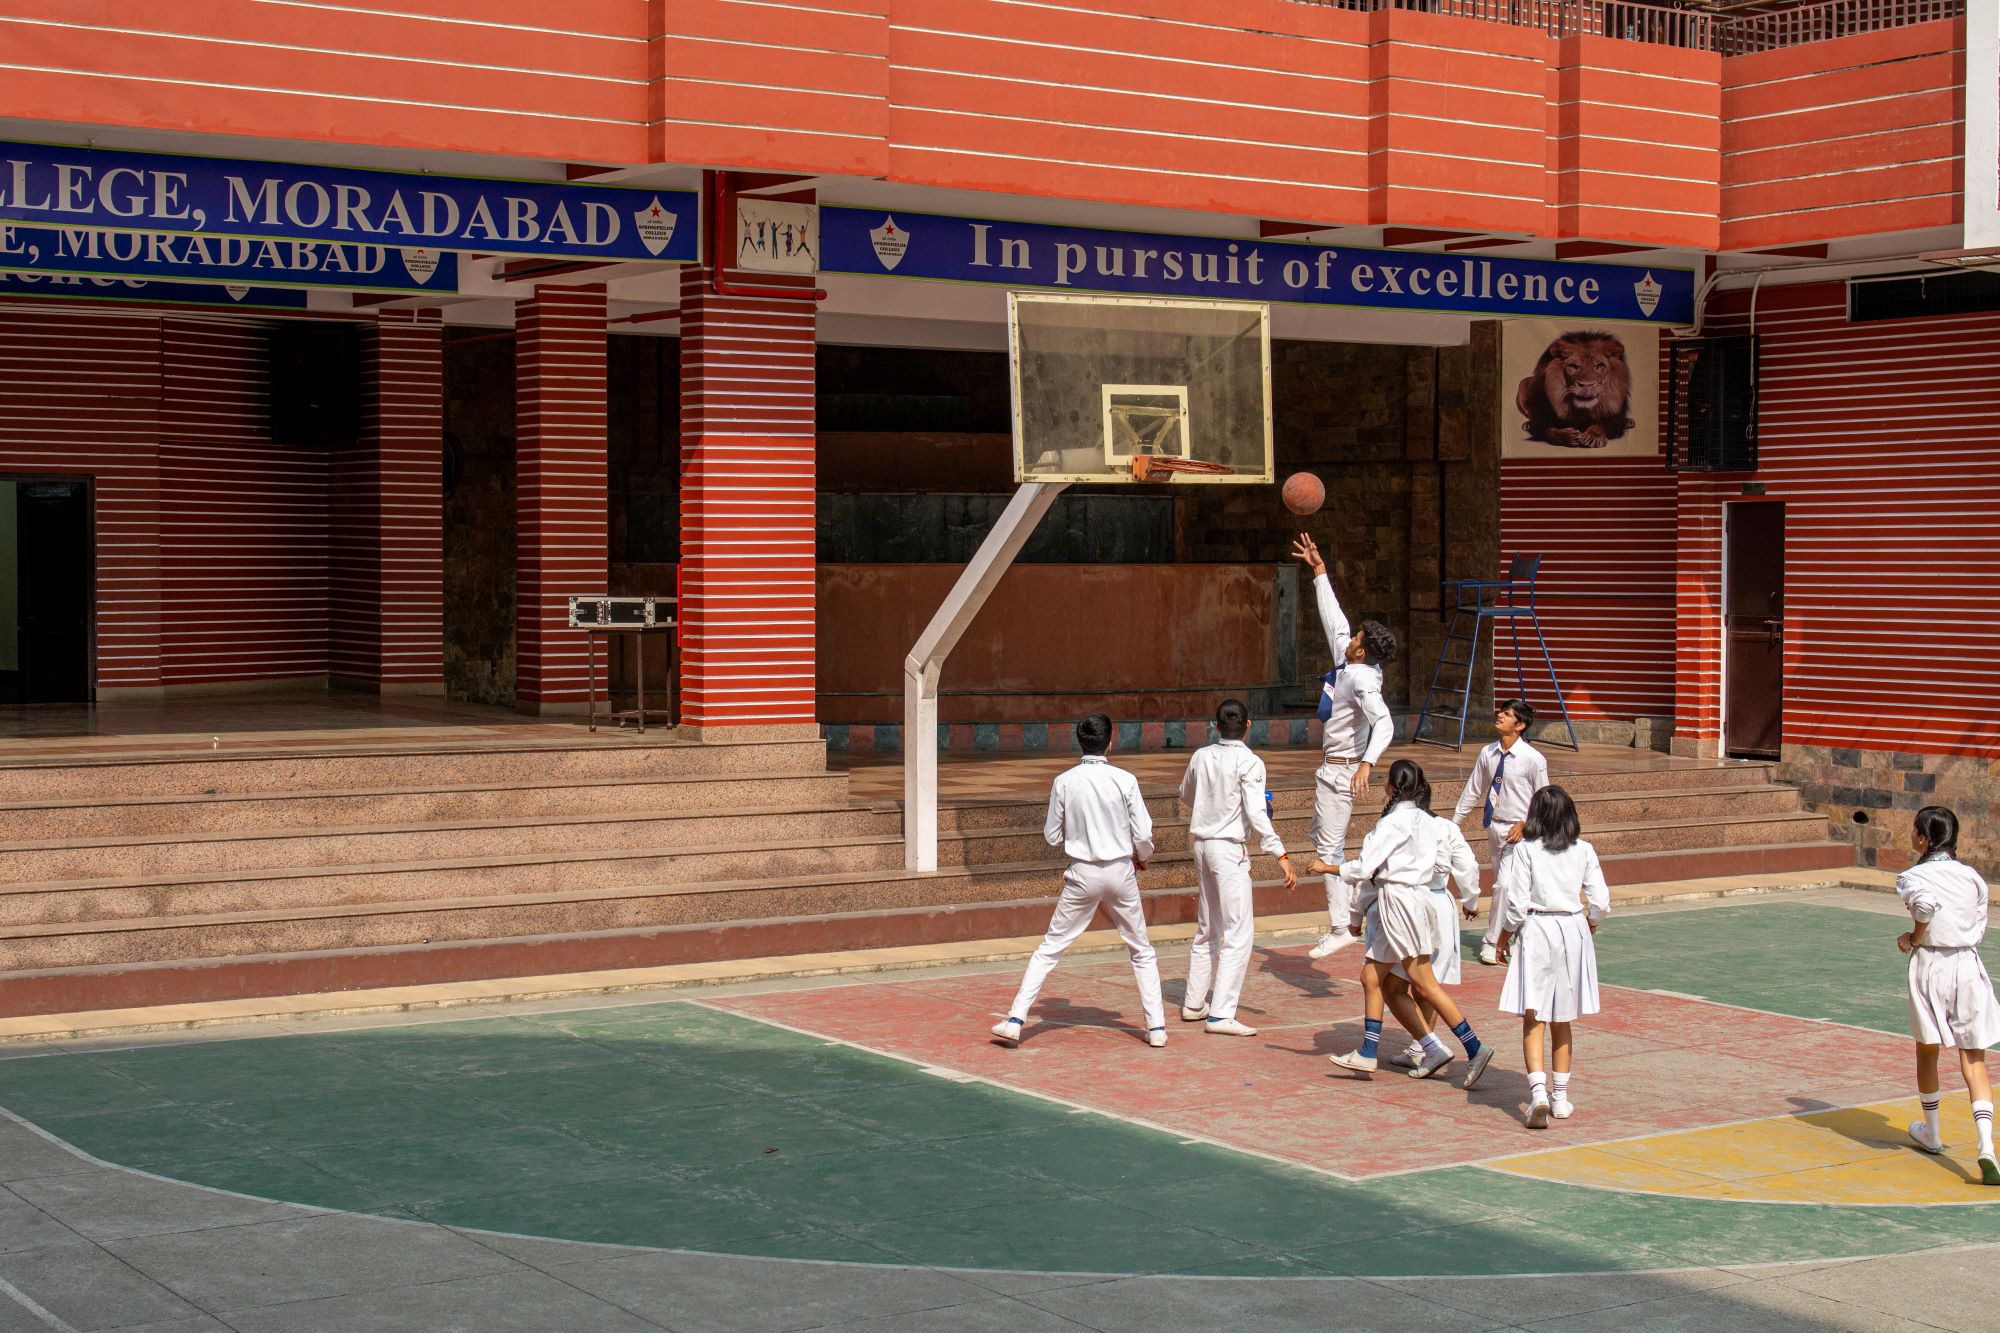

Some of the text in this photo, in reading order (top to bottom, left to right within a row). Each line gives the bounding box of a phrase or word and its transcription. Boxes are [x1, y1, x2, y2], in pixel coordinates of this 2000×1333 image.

[0, 160, 621, 246] LEGE, MORADABAD
[54, 229, 386, 275] MORADABAD
[968, 223, 1600, 304] In pursuit of excellence
